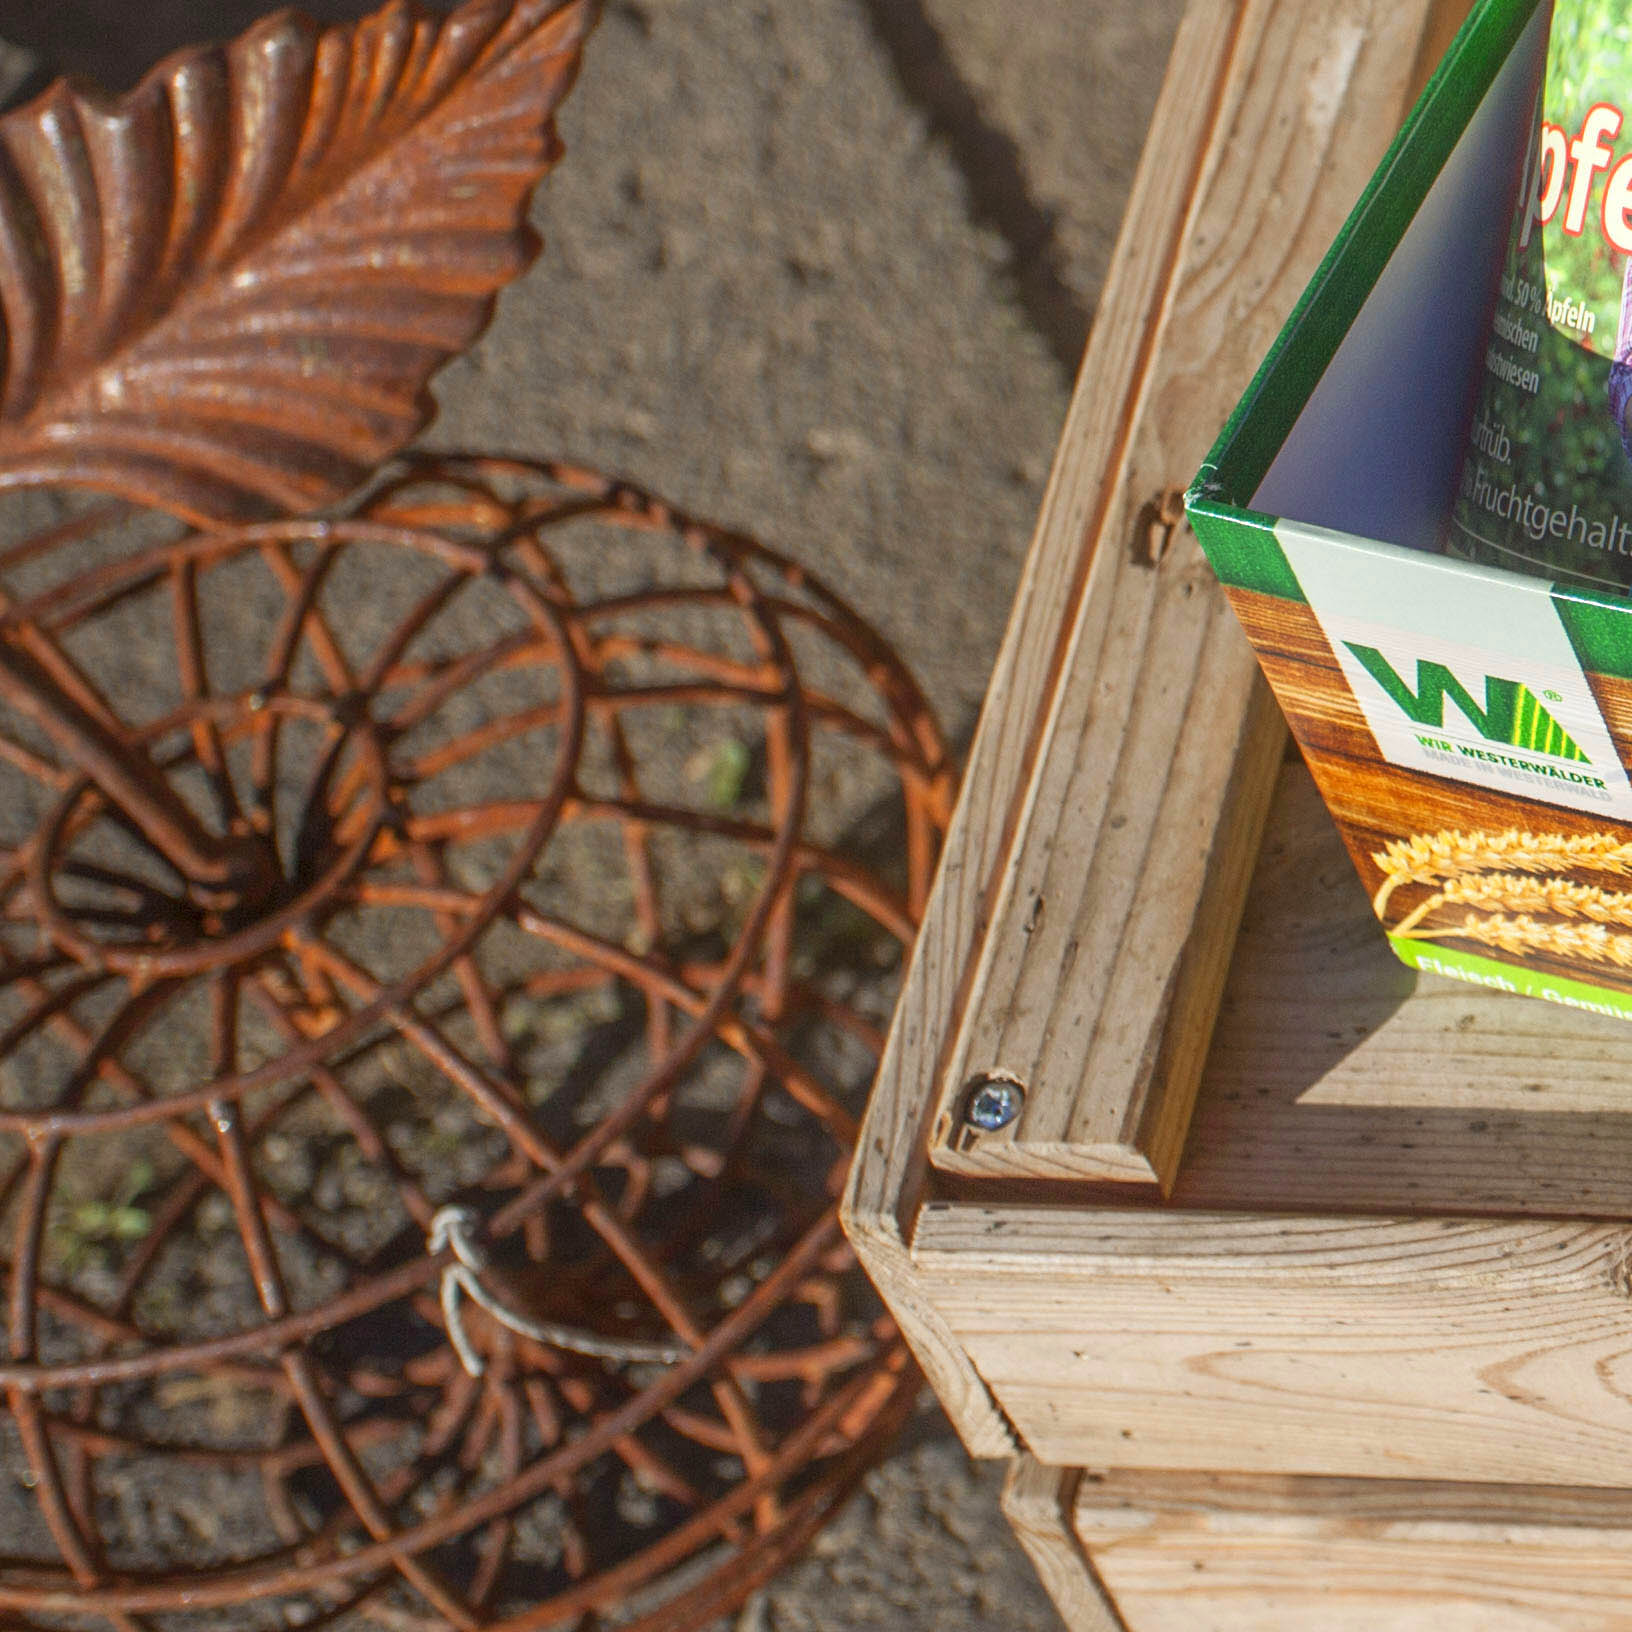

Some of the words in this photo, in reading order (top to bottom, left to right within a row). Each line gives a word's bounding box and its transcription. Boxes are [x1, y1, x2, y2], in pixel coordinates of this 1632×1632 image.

[1414, 733, 1454, 753] WIR
[1456, 744, 1609, 790] WESTERWÄLDER
[1414, 954, 1517, 993] Fleisch
